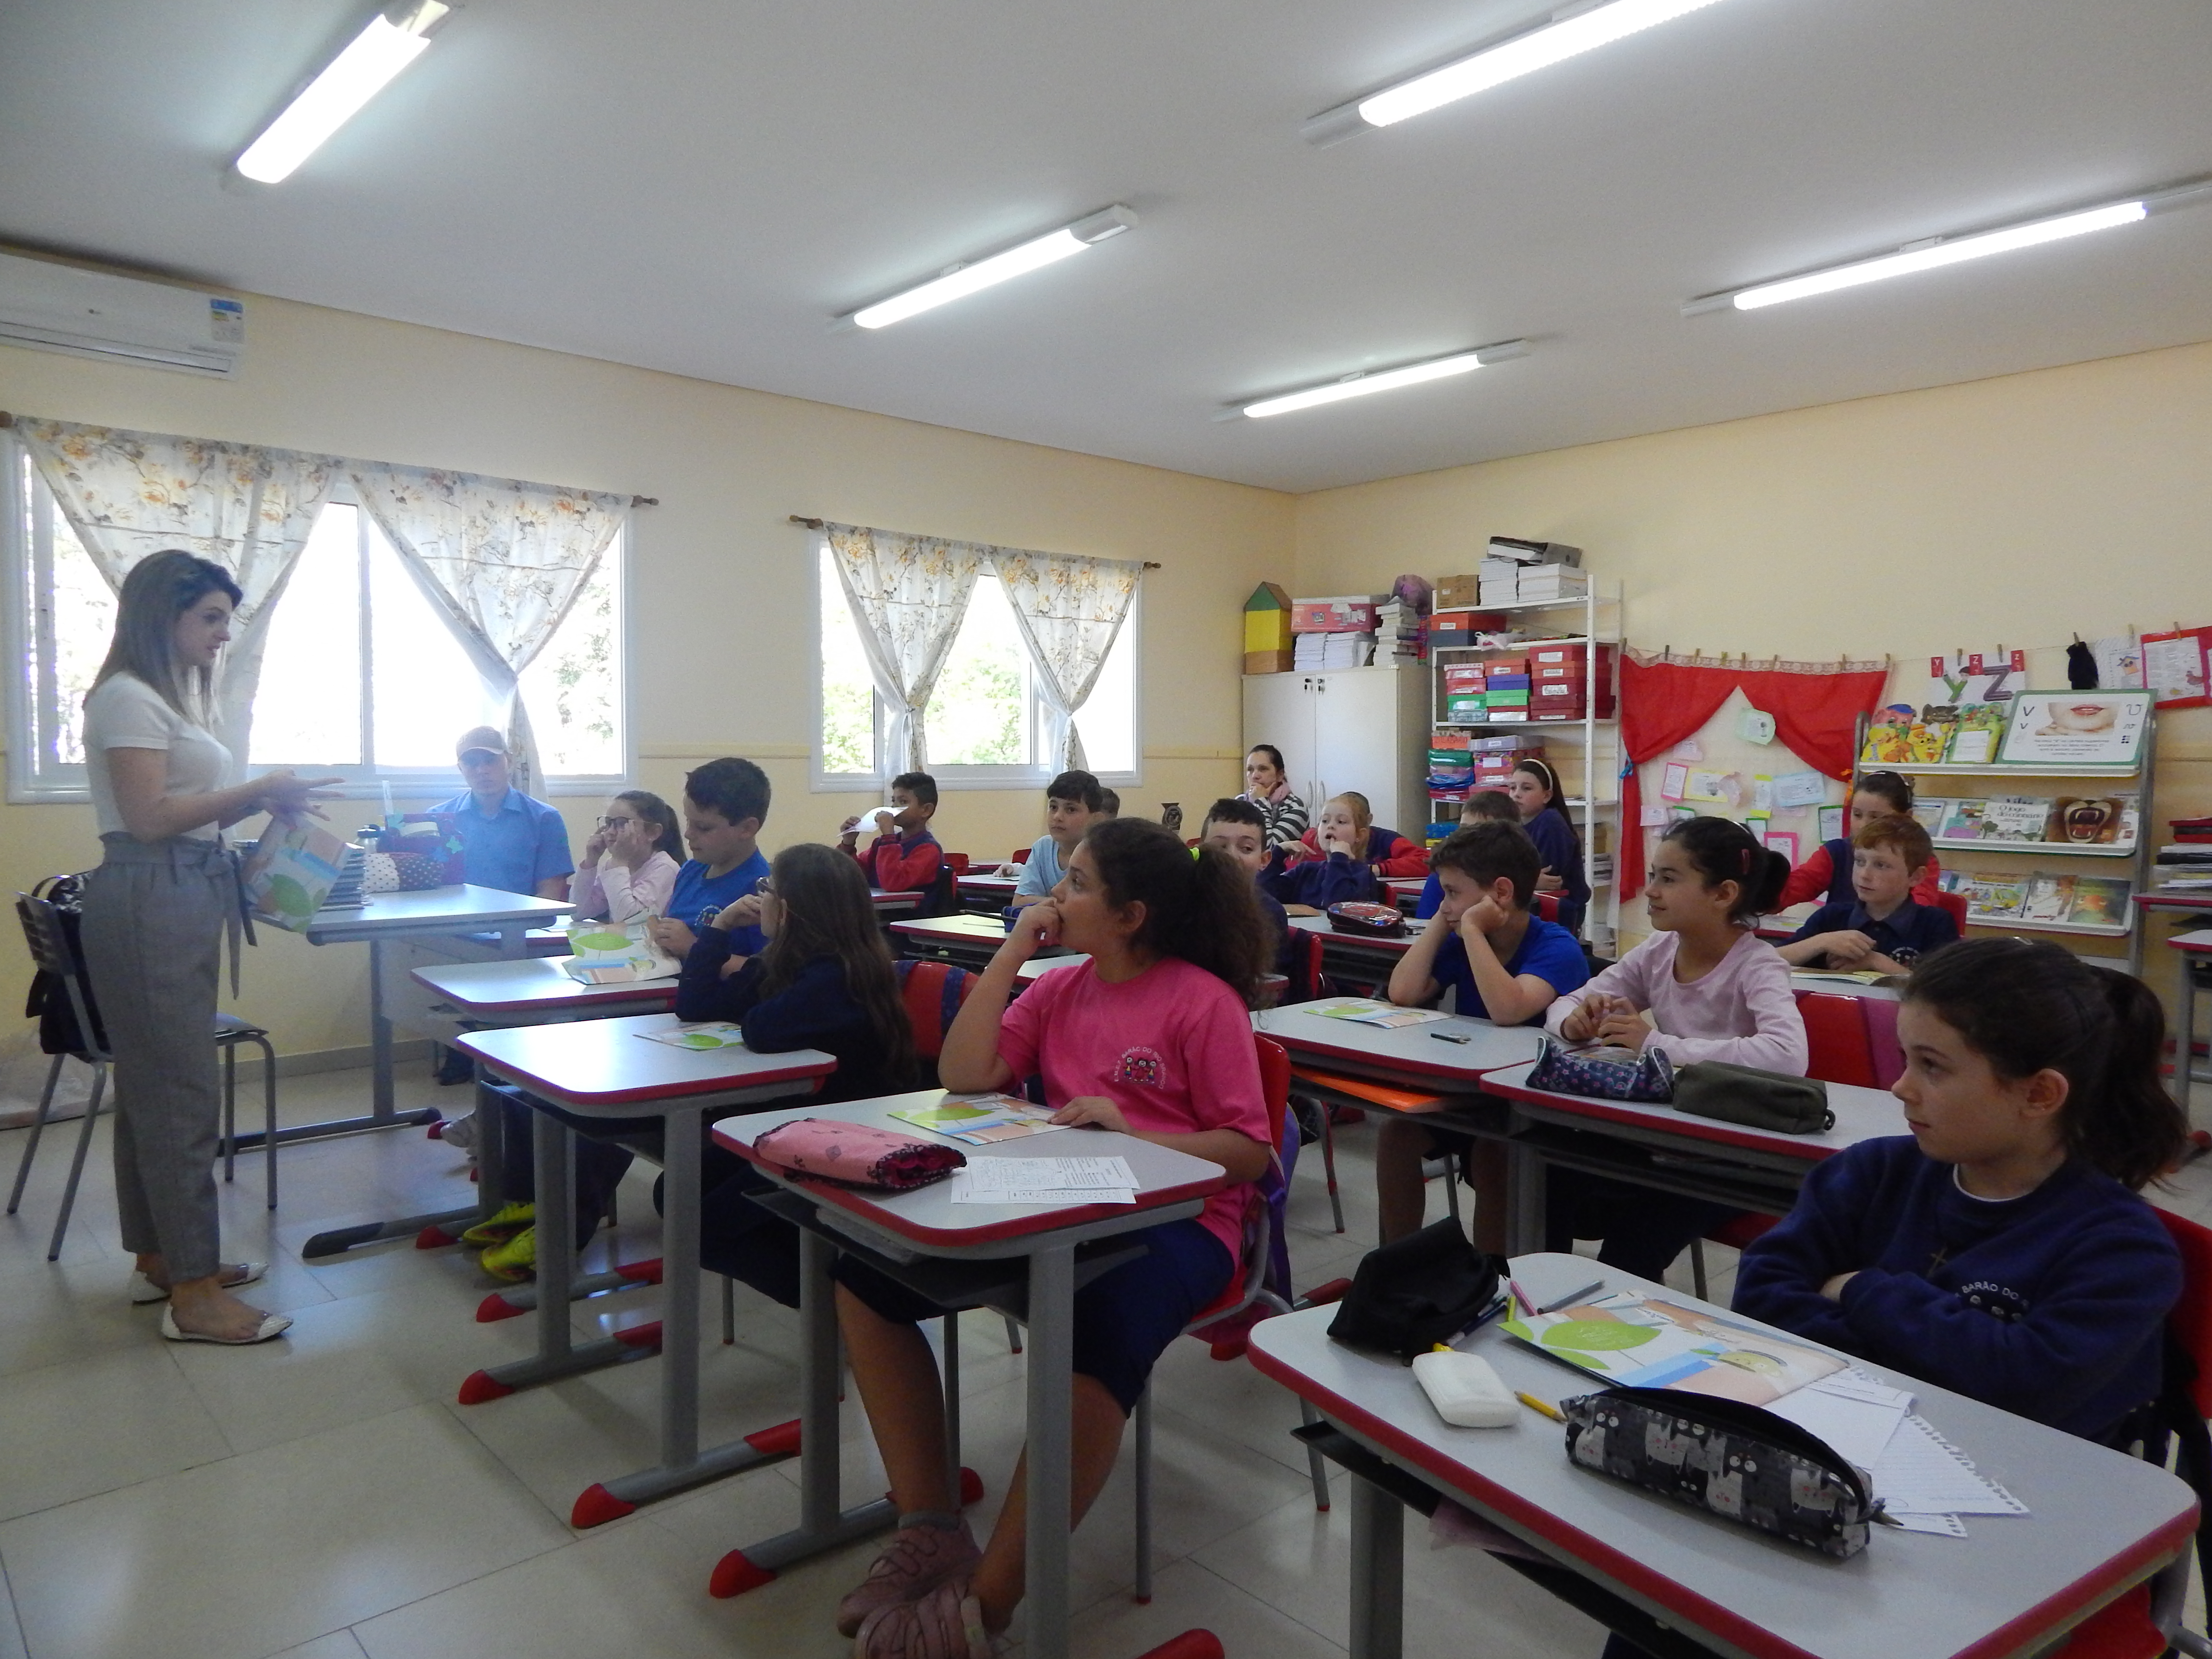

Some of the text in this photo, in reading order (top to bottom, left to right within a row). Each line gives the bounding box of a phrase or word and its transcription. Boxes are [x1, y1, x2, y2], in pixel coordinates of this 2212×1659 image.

[1983, 665, 2012, 701] Z
[2023, 706, 2035, 717] V
[1961, 1281, 2019, 1300] BARÃO DO
